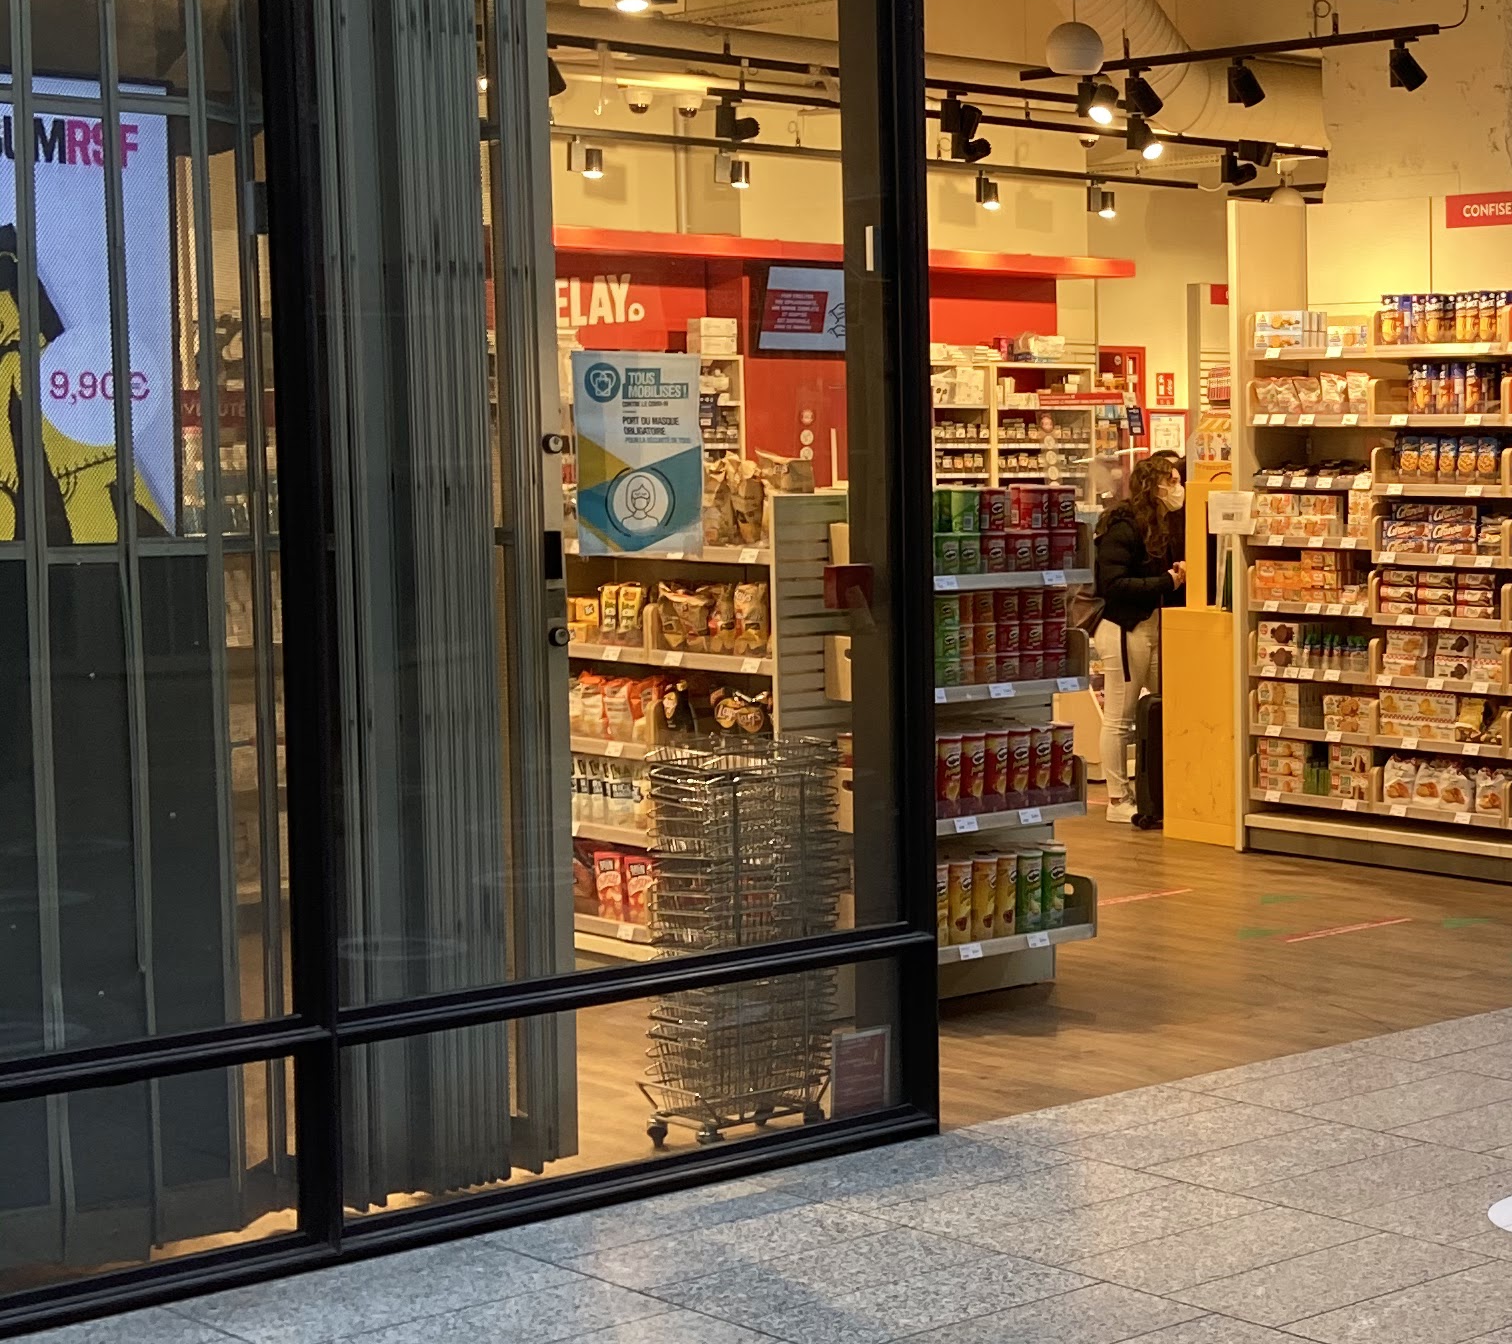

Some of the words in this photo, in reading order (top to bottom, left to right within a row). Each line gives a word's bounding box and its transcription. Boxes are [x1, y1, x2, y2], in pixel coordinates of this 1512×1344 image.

[628, 372, 656, 385] TOUS
[622, 416, 640, 426] PORT
[652, 416, 680, 426] MASQUE
[624, 426, 666, 436] OBLIGATOIRE
